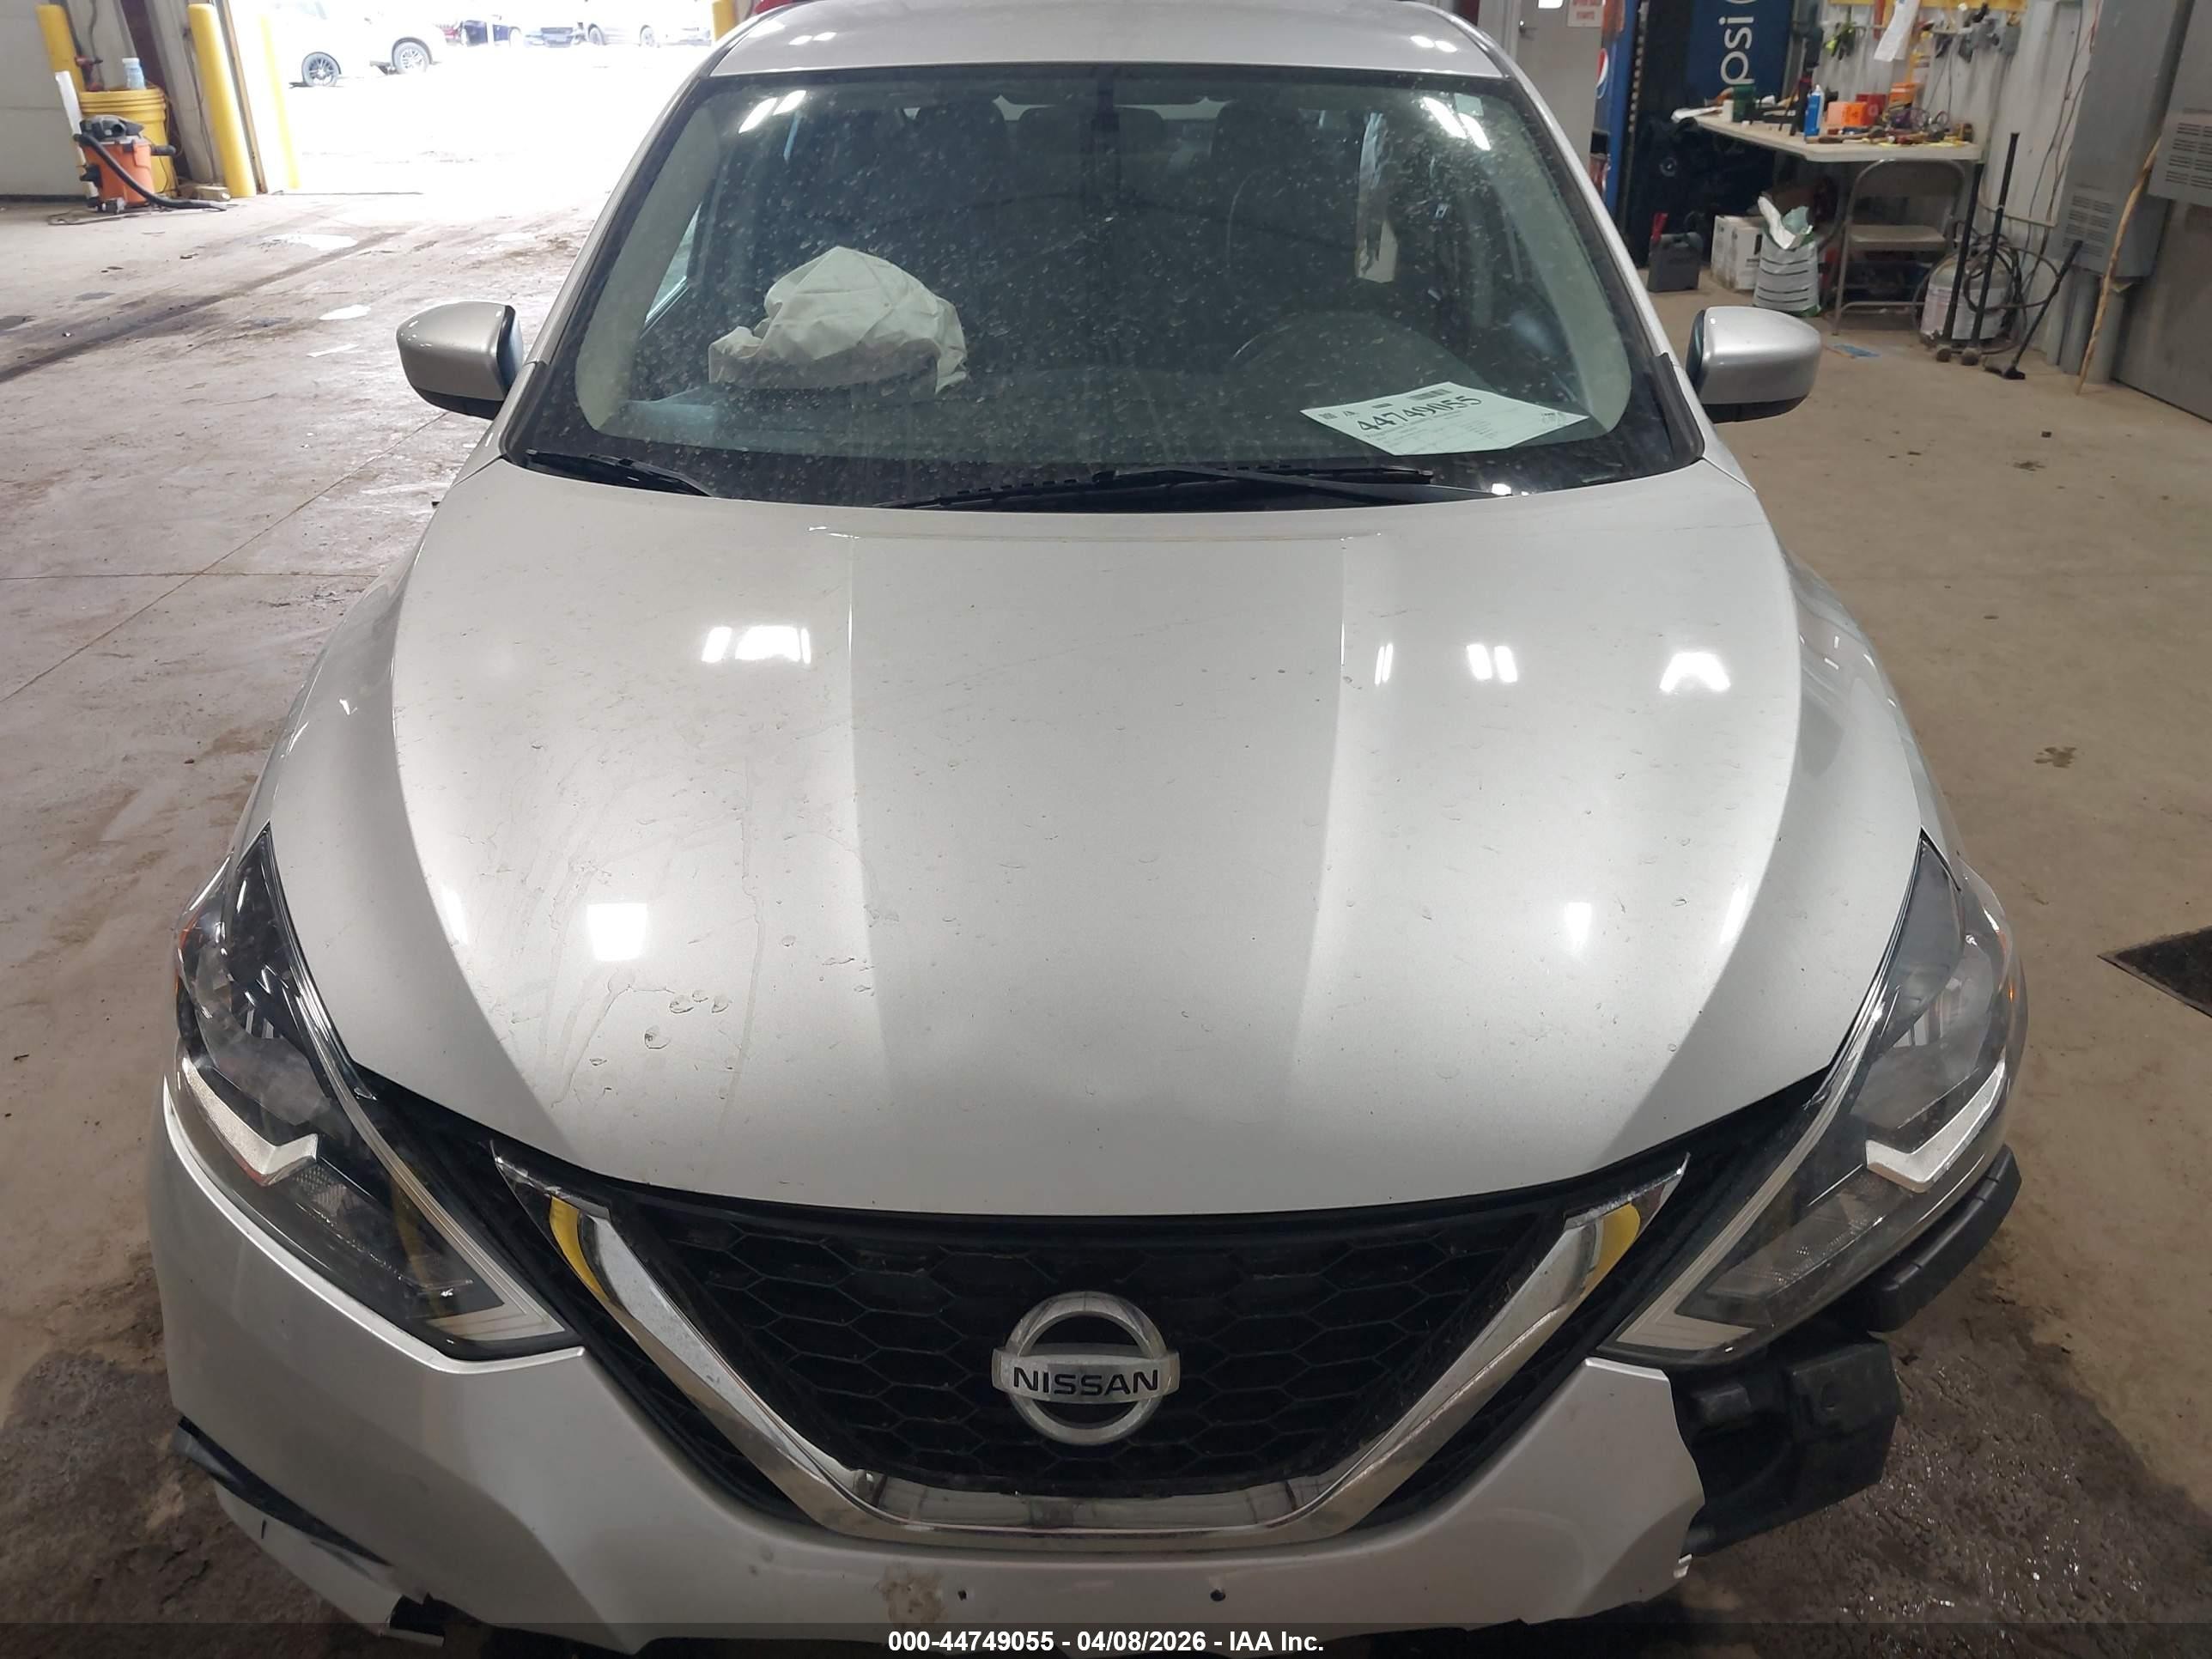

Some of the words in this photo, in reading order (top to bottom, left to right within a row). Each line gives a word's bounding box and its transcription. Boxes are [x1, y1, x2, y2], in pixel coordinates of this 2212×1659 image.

[1718, 16, 1755, 85] psi
[1357, 395, 1482, 431] 44749055
[1012, 1366, 1158, 1396] NISSAN
